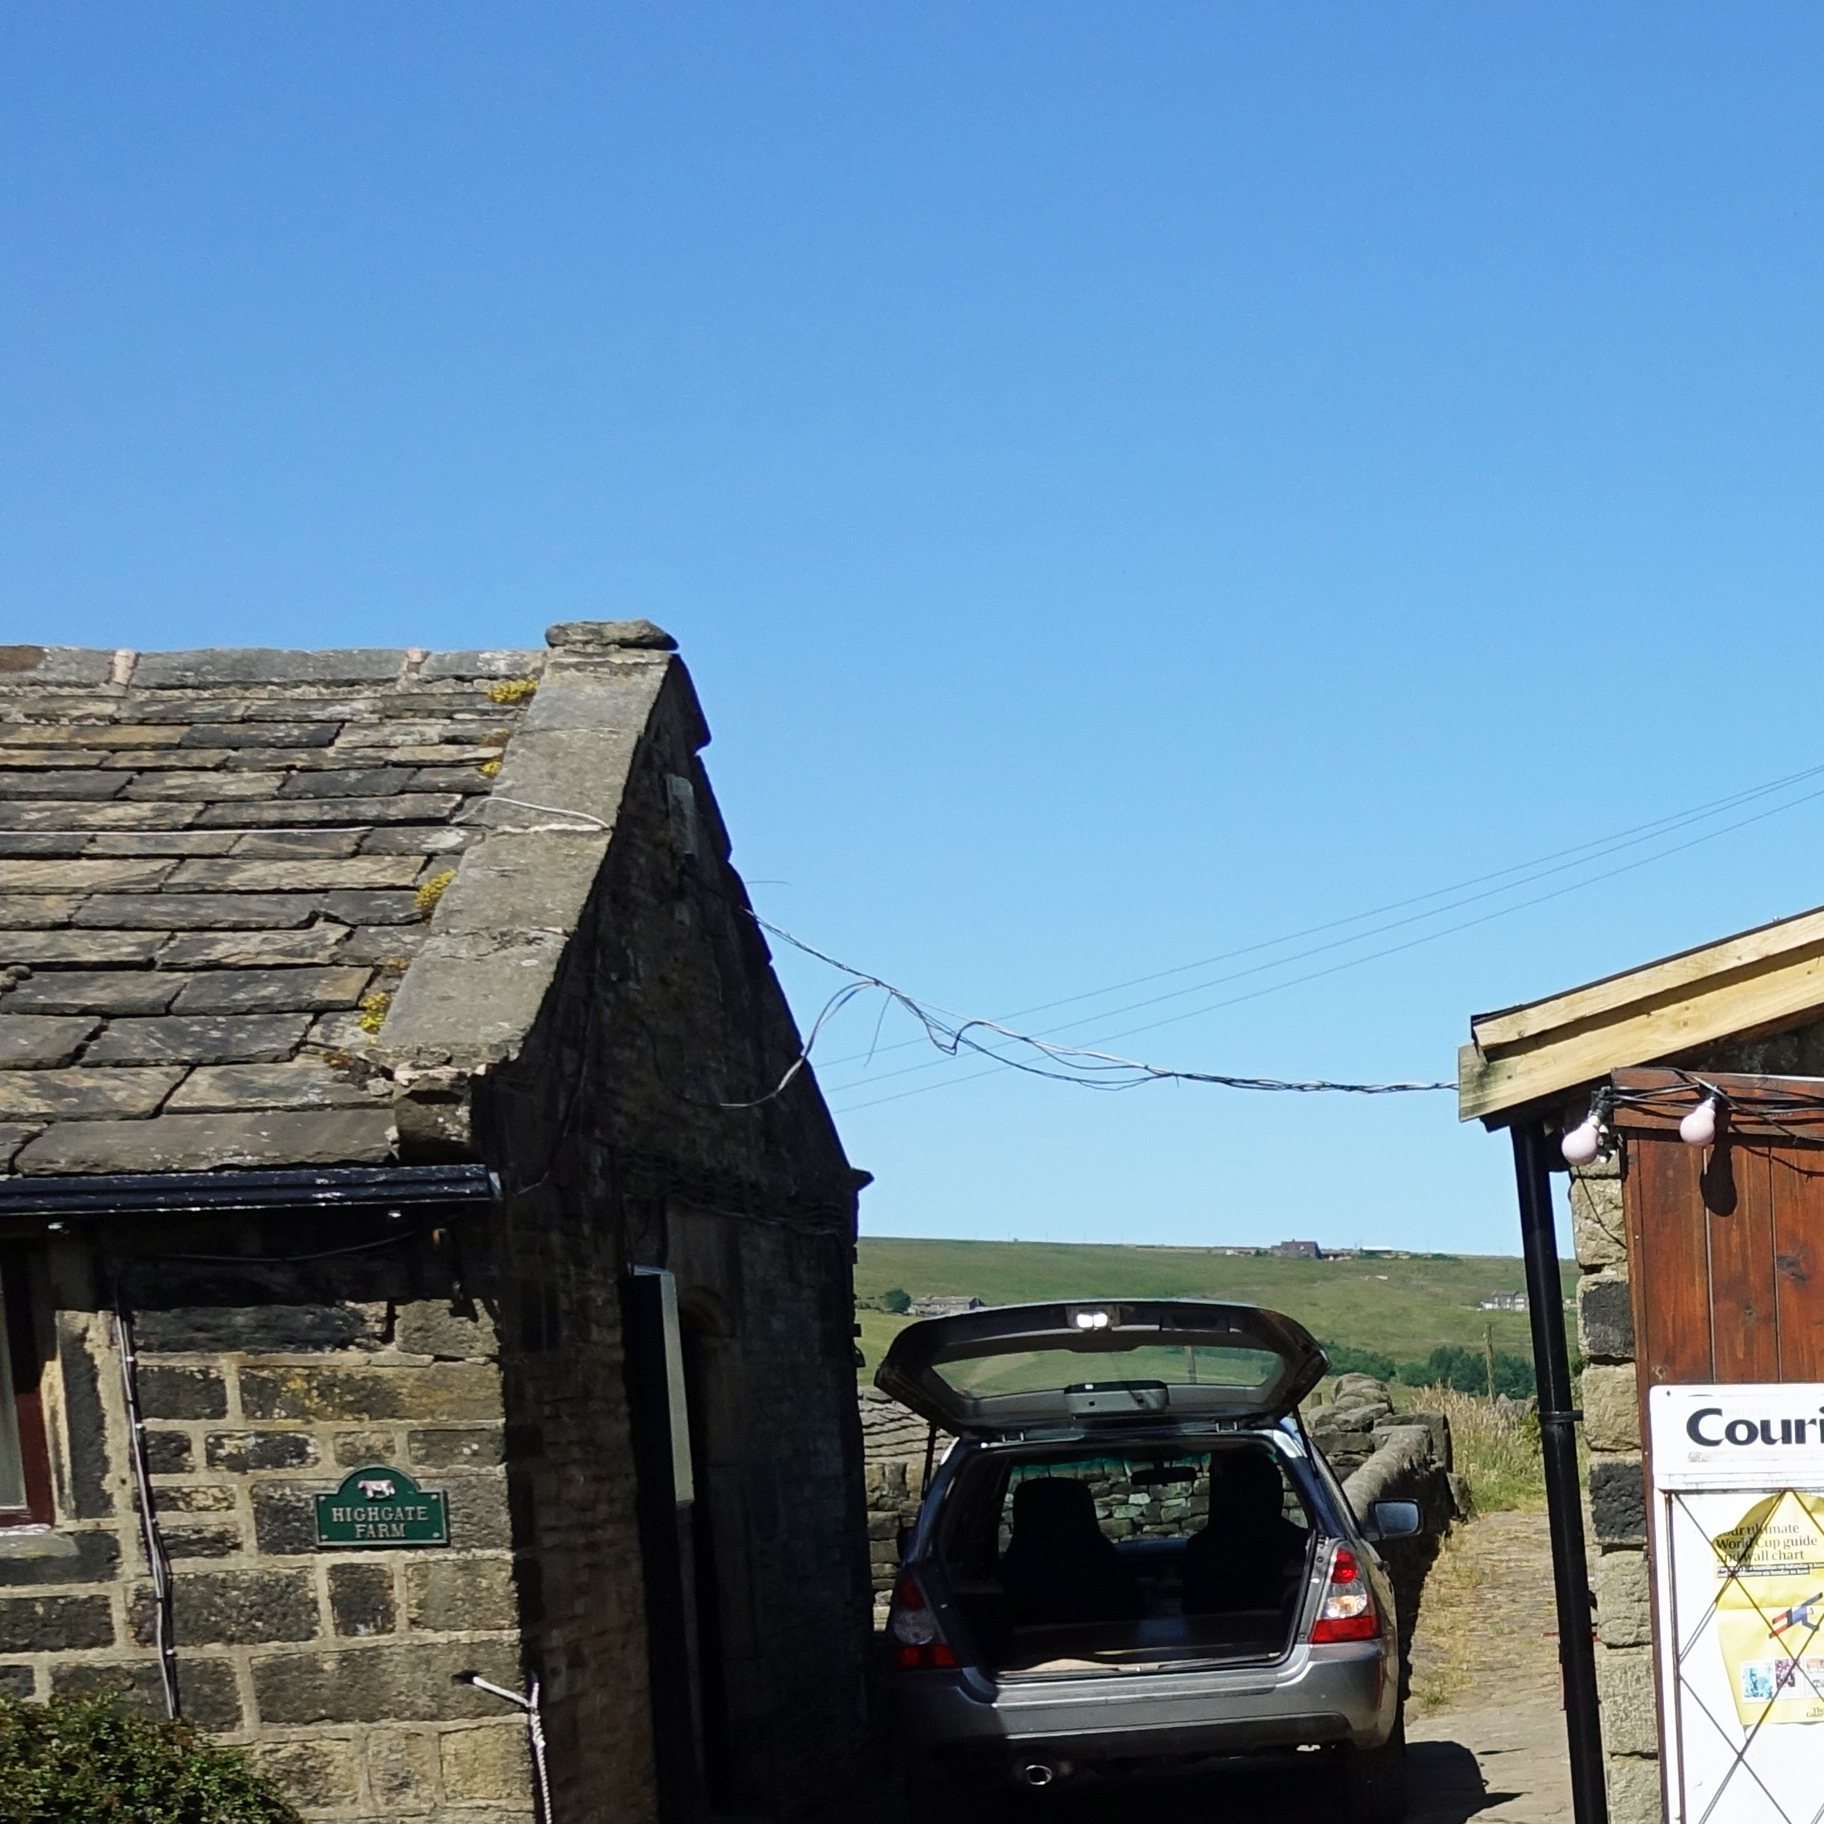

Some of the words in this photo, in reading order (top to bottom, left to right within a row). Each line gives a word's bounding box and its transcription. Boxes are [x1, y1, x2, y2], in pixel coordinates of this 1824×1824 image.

[331, 1506, 428, 1522] HIGHGATE
[355, 1523, 406, 1539] FARM
[1757, 1537, 1780, 1549] Cup
[1783, 1535, 1818, 1550] guide
[1771, 1549, 1804, 1561] chart
